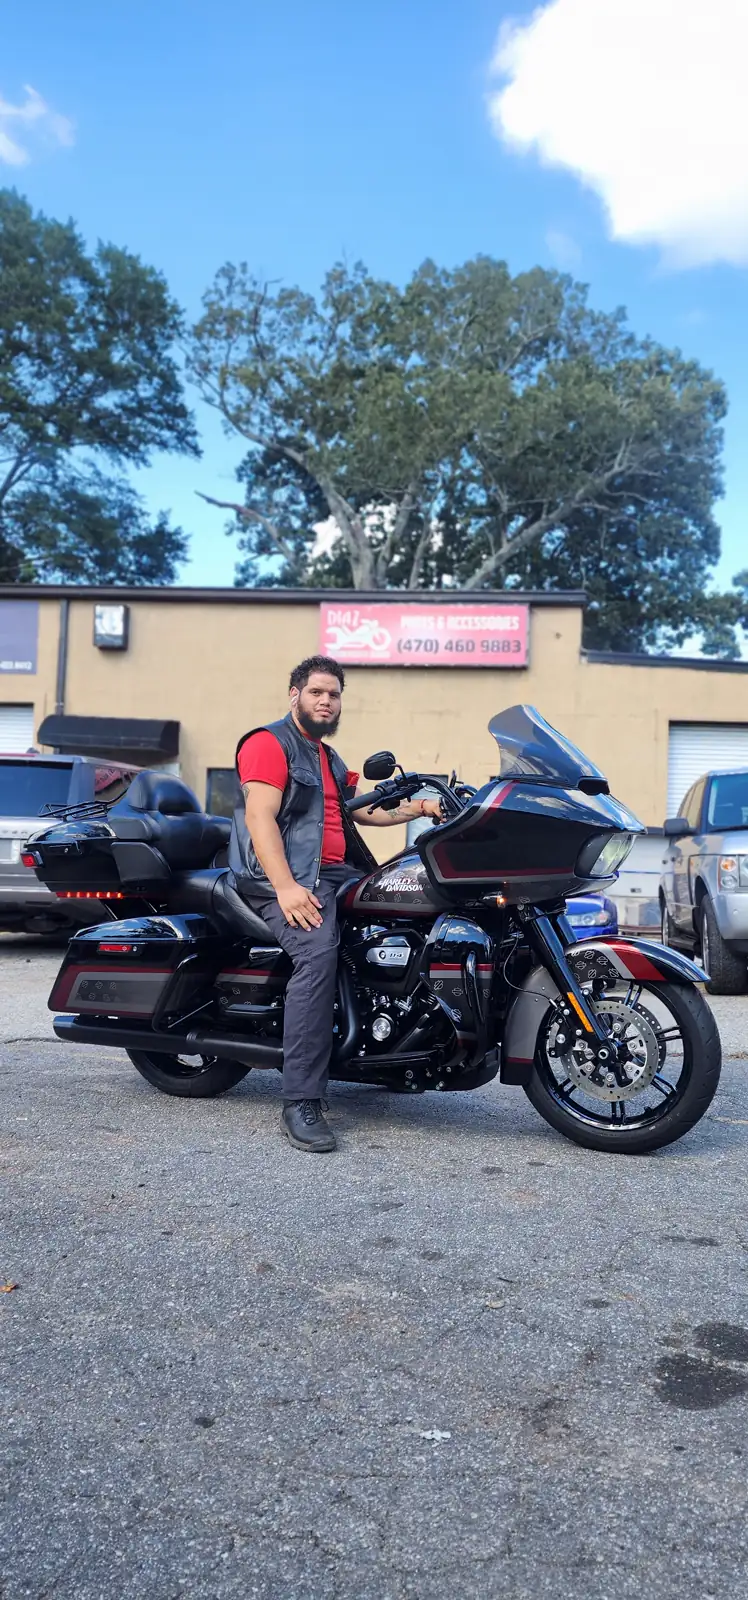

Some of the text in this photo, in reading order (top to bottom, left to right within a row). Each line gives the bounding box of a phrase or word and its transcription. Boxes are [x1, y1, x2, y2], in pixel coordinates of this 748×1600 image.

[327, 610, 360, 626] DIAZ
[447, 615, 520, 631] ACCESSORIES
[397, 638, 440, 654] (470)
[444, 639, 476, 653] 460
[480, 639, 522, 653] 9883
[385, 884, 425, 892] DAVIDSON
